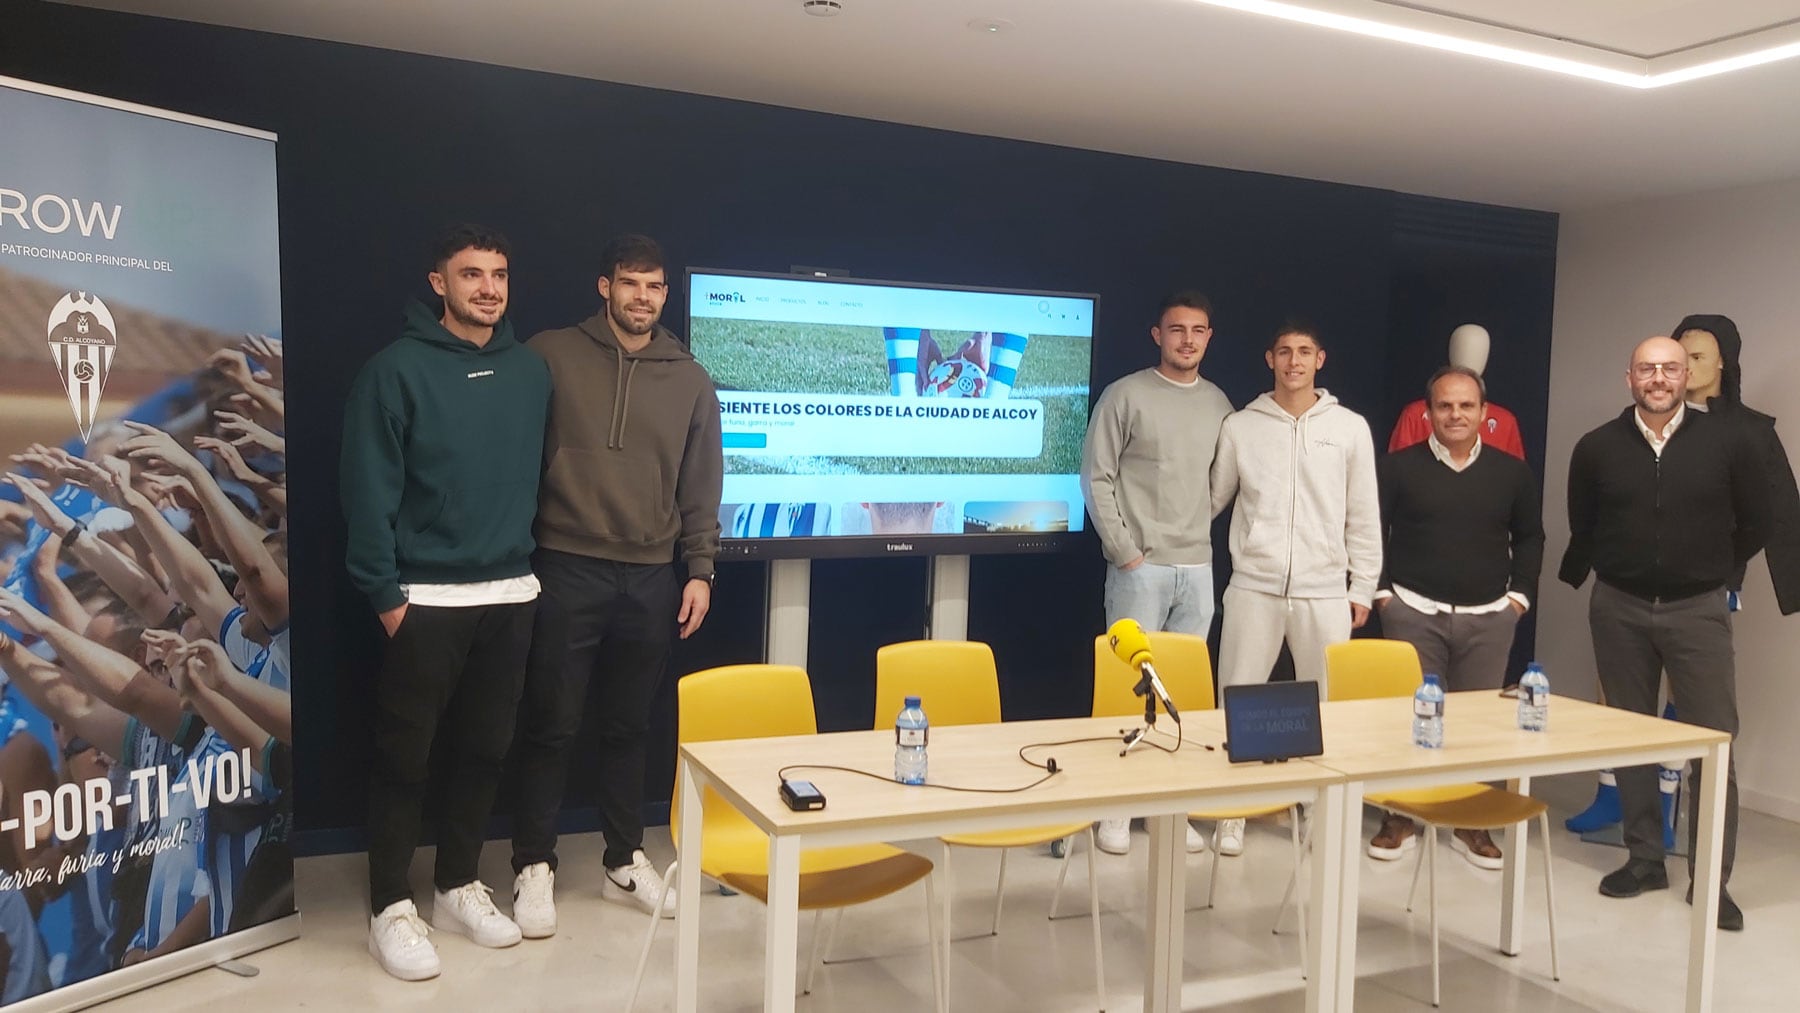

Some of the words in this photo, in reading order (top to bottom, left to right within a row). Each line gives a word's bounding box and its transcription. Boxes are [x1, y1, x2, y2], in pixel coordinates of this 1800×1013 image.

[0, 188, 122, 240] ROW
[1, 243, 93, 263] PATROCINADOR
[95, 254, 150, 270] PRINCIPAL
[153, 260, 173, 272] DEL
[75, 337, 106, 345] ALCOYANO
[719, 401, 770, 414] SIENTE
[773, 403, 801, 415] LOS
[805, 404, 872, 416] COLORES
[875, 405, 893, 417] DE
[896, 406, 912, 417] LA
[916, 406, 970, 419] CIUDAD
[973, 408, 990, 419] DE
[992, 408, 1038, 420] ALCOY
[1266, 717, 1309, 734] MORAL
[0, 867, 52, 891] arra,
[57, 848, 109, 885] furia
[112, 848, 125, 874] y
[129, 820, 185, 858] moral!
